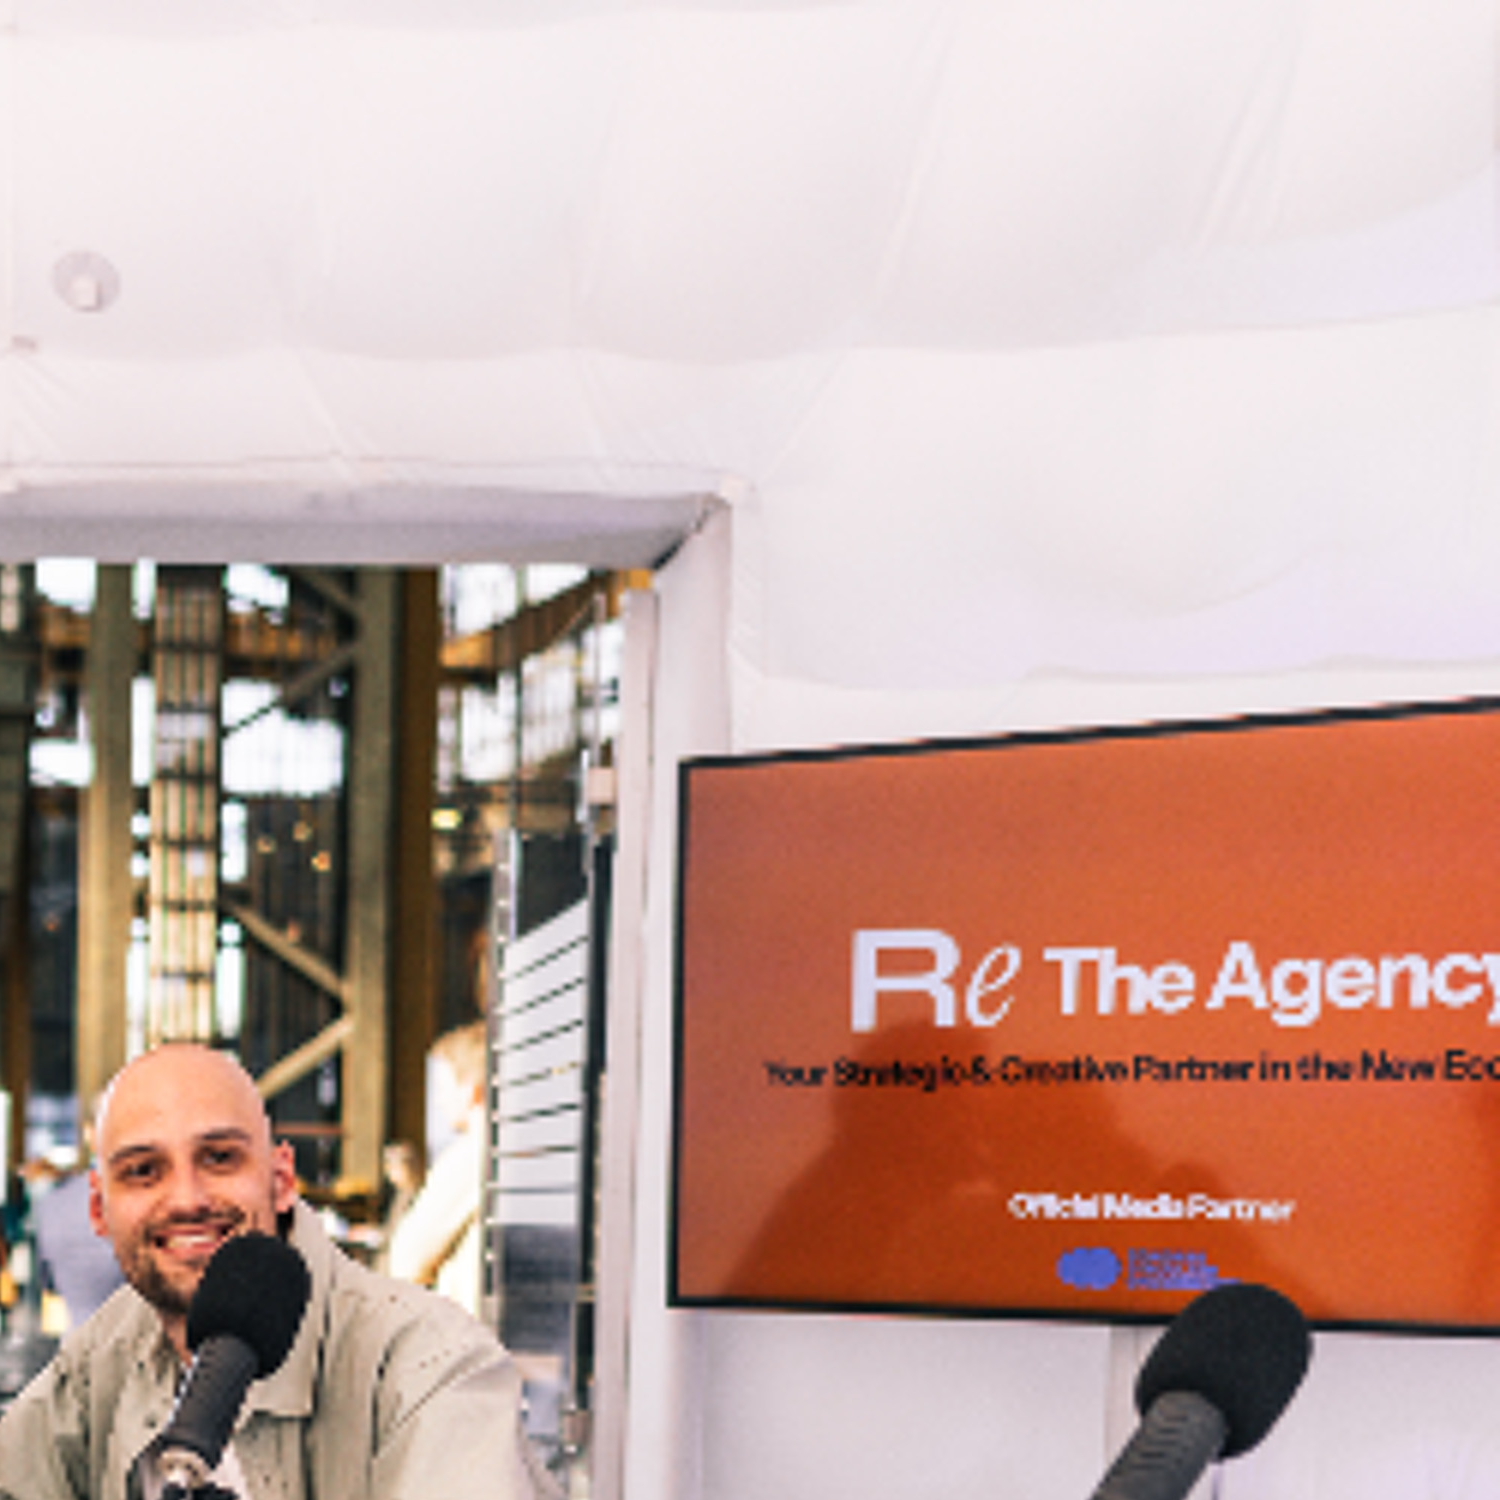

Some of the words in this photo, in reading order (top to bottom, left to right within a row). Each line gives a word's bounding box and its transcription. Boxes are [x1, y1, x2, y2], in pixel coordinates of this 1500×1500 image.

[851, 928, 1021, 1032] Re
[1043, 946, 1195, 1016] The
[762, 1056, 828, 1087] Your
[833, 1055, 964, 1093] Strategic
[1001, 1055, 1129, 1086] Creative
[1133, 1054, 1255, 1083] Partner
[1259, 1050, 1292, 1082] in
[1297, 1050, 1352, 1082] the
[1360, 1049, 1436, 1082] New
[1007, 1192, 1099, 1220] Official
[1102, 1192, 1183, 1220] Media
[1186, 1192, 1296, 1223] Partner
